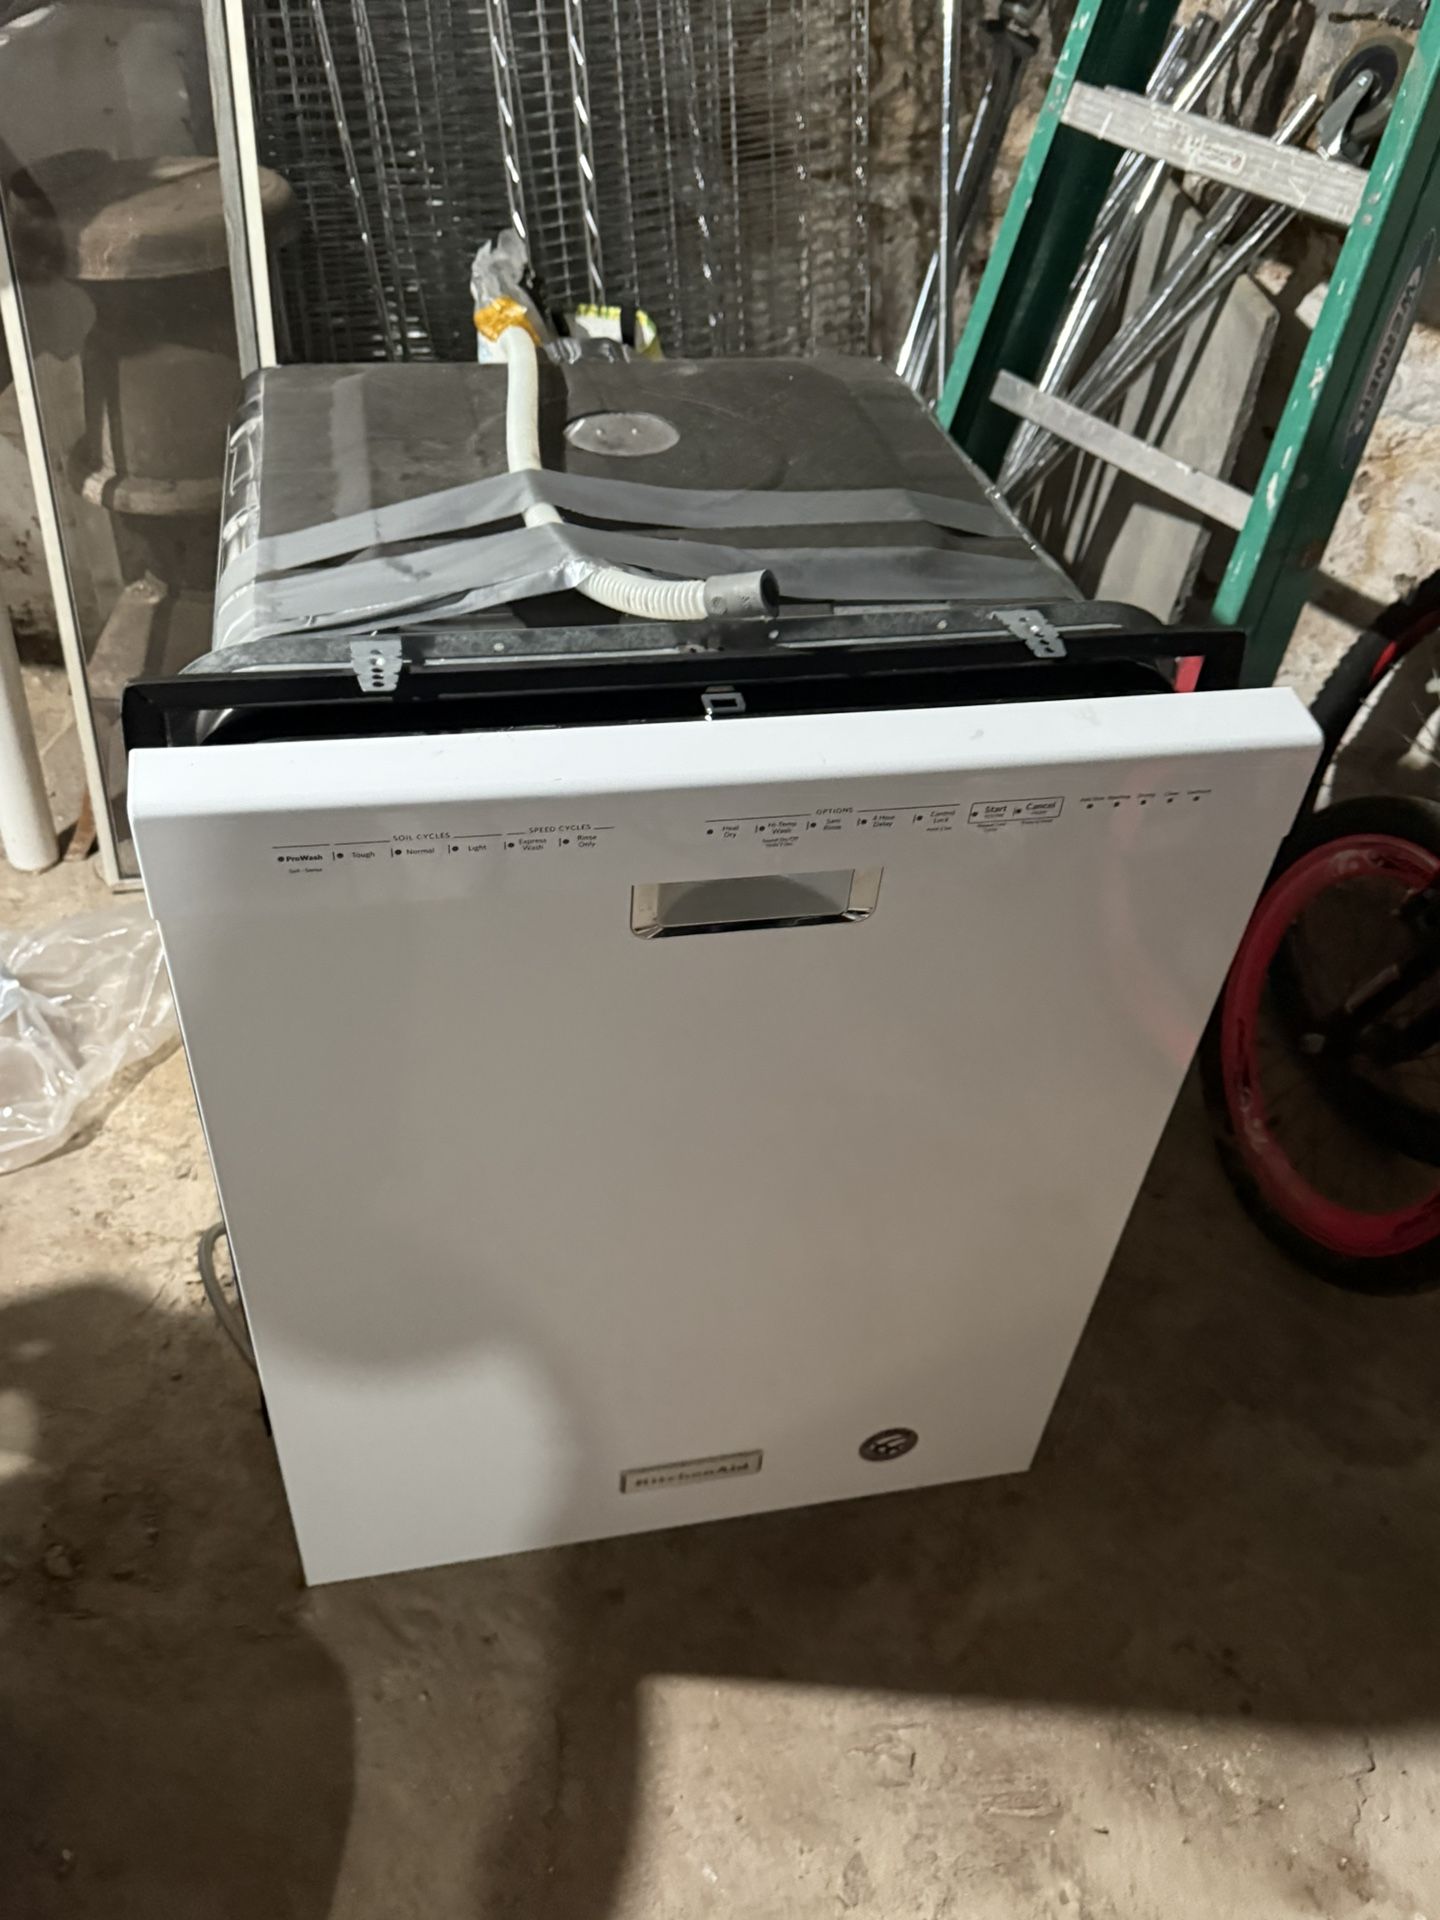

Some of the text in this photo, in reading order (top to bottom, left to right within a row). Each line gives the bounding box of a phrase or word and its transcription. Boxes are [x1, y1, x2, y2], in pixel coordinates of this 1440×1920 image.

[985, 805, 1007, 813] Start
[1025, 801, 1057, 810] Cancel
[815, 807, 853, 816] OPTIONS
[528, 824, 592, 834] SPEED CYCLES
[392, 832, 450, 842] SOIL CYCLES
[518, 838, 547, 847] Express
[406, 847, 435, 855] Normal
[467, 844, 487, 853] Light
[286, 854, 323, 862] ProWash
[352, 850, 376, 859] Tough
